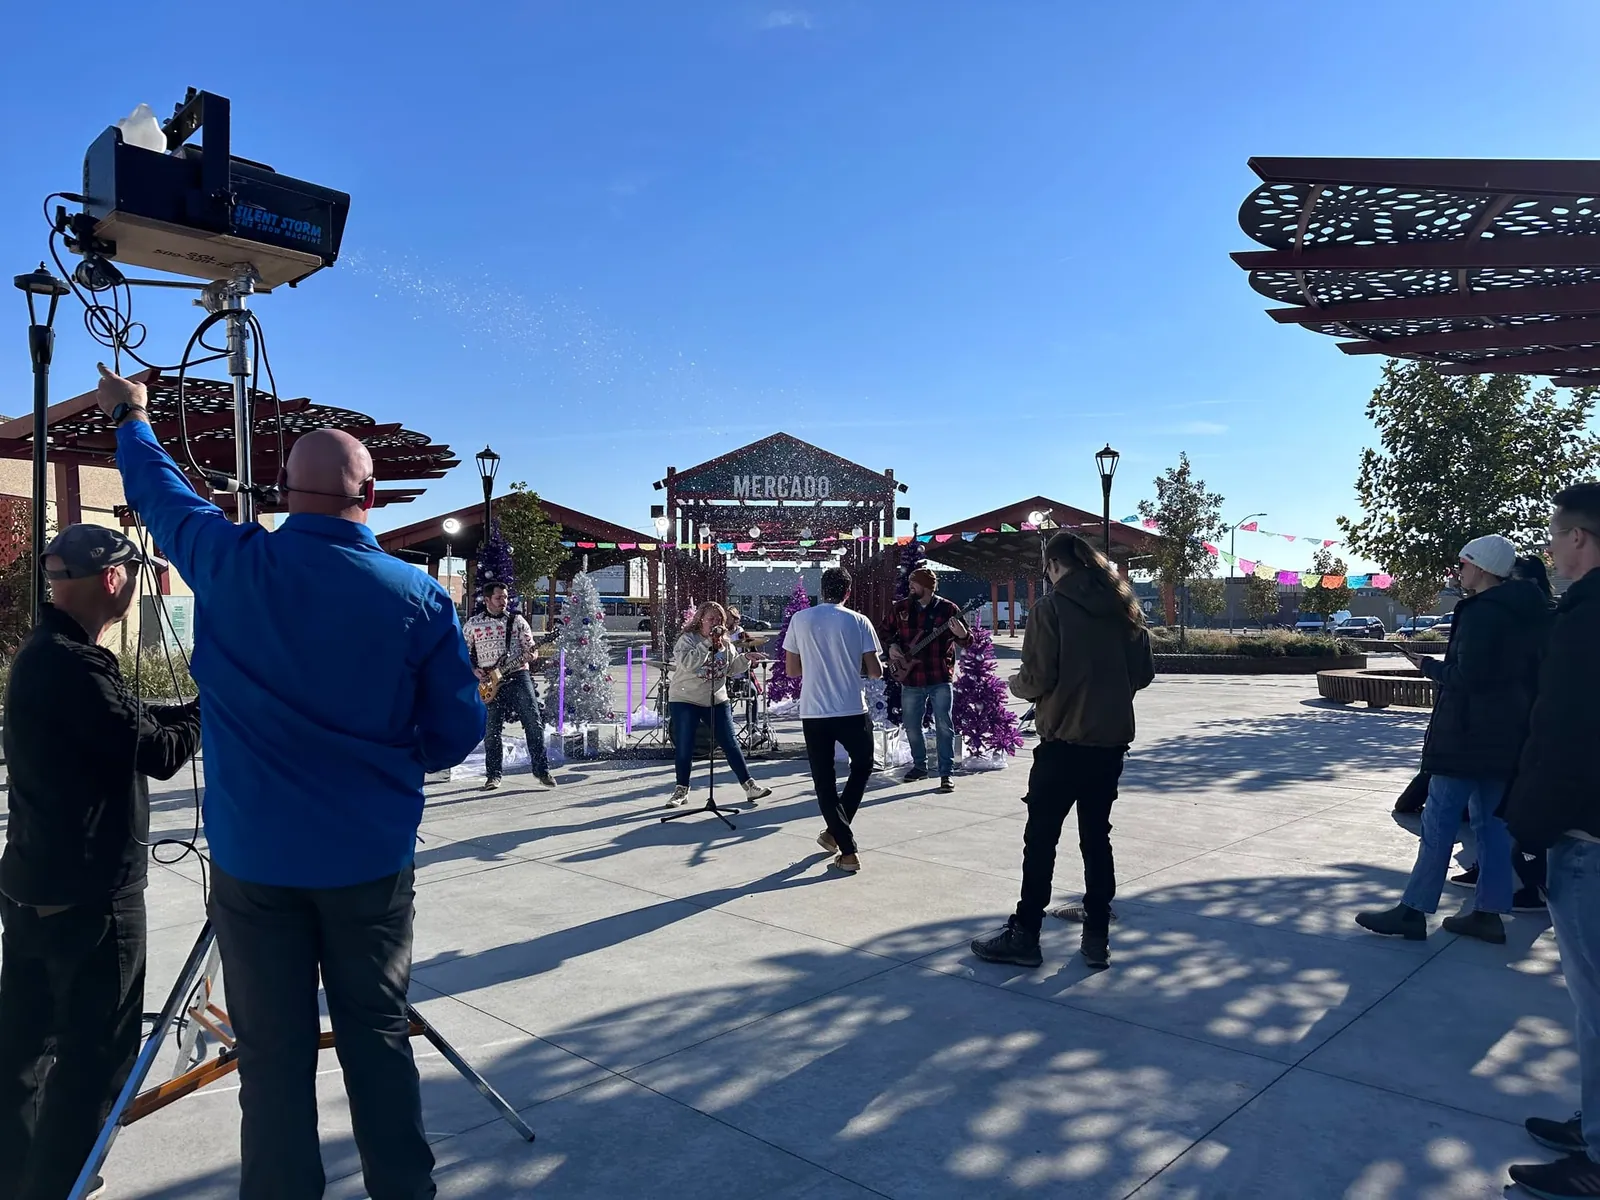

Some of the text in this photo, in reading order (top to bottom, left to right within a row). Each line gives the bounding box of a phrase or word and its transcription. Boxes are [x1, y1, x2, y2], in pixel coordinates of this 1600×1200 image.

[234, 204, 322, 238] SILENT STORM
[284, 230, 322, 245] MACHINE
[733, 474, 831, 499] MERCADO
